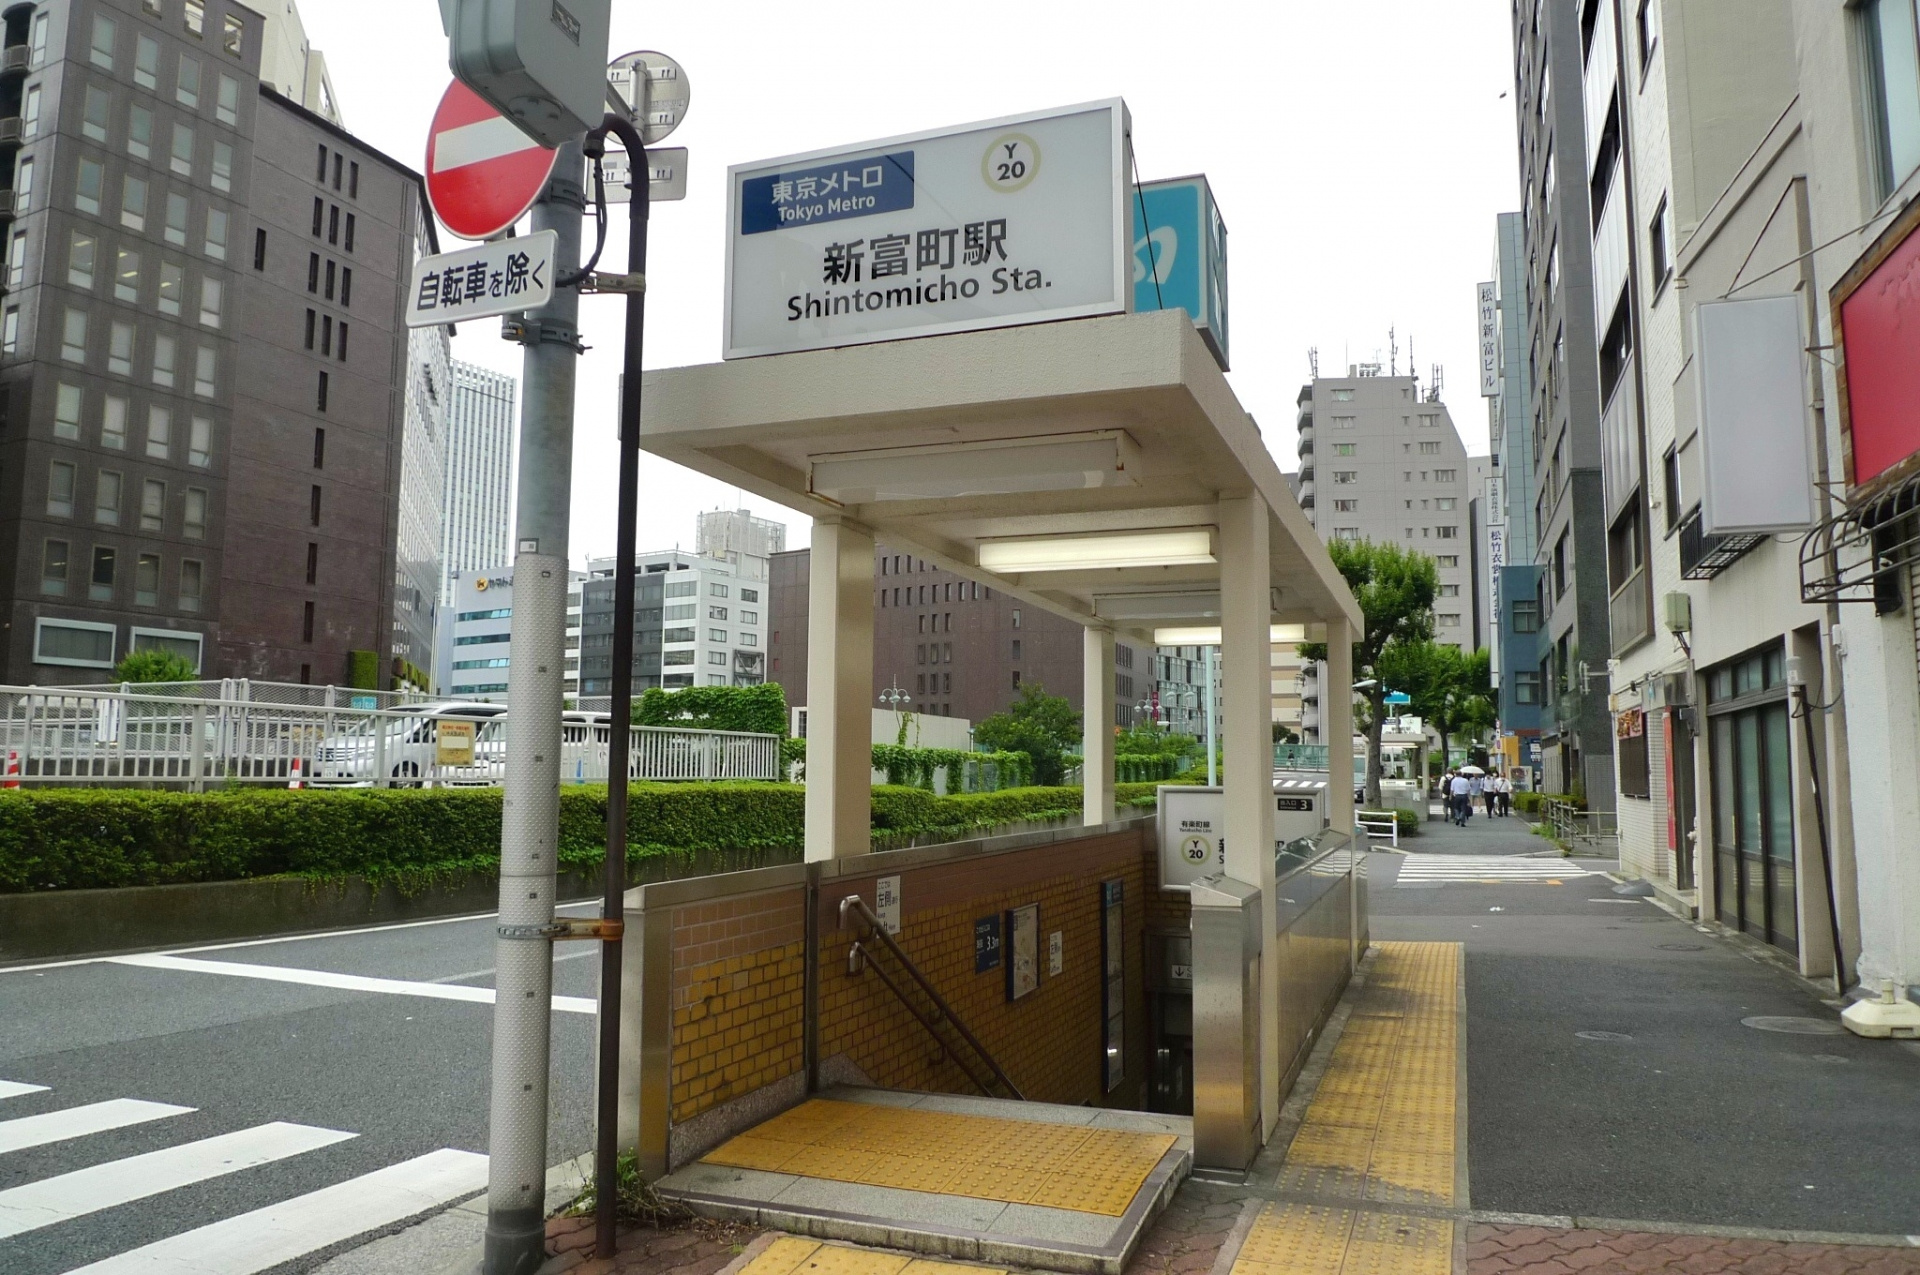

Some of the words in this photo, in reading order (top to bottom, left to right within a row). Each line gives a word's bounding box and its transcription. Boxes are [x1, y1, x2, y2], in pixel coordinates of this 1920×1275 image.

[1004, 143, 1018, 160] Y
[997, 160, 1026, 181] 20
[771, 165, 883, 205] 東京メトロ
[778, 205, 824, 222] Tokyo
[828, 195, 876, 214] Metro
[823, 218, 1008, 286] 新富町駅
[417, 251, 545, 311] 自転車を除く
[787, 274, 980, 322] Shintomicho
[992, 267, 1052, 295] Sta.
[1481, 288, 1495, 388] 松竹新富ビル
[1300, 799, 1308, 810] 3
[1181, 820, 1210, 828] 有楽町線
[1188, 849, 1204, 859] 20
[1192, 840, 1199, 848] Y
